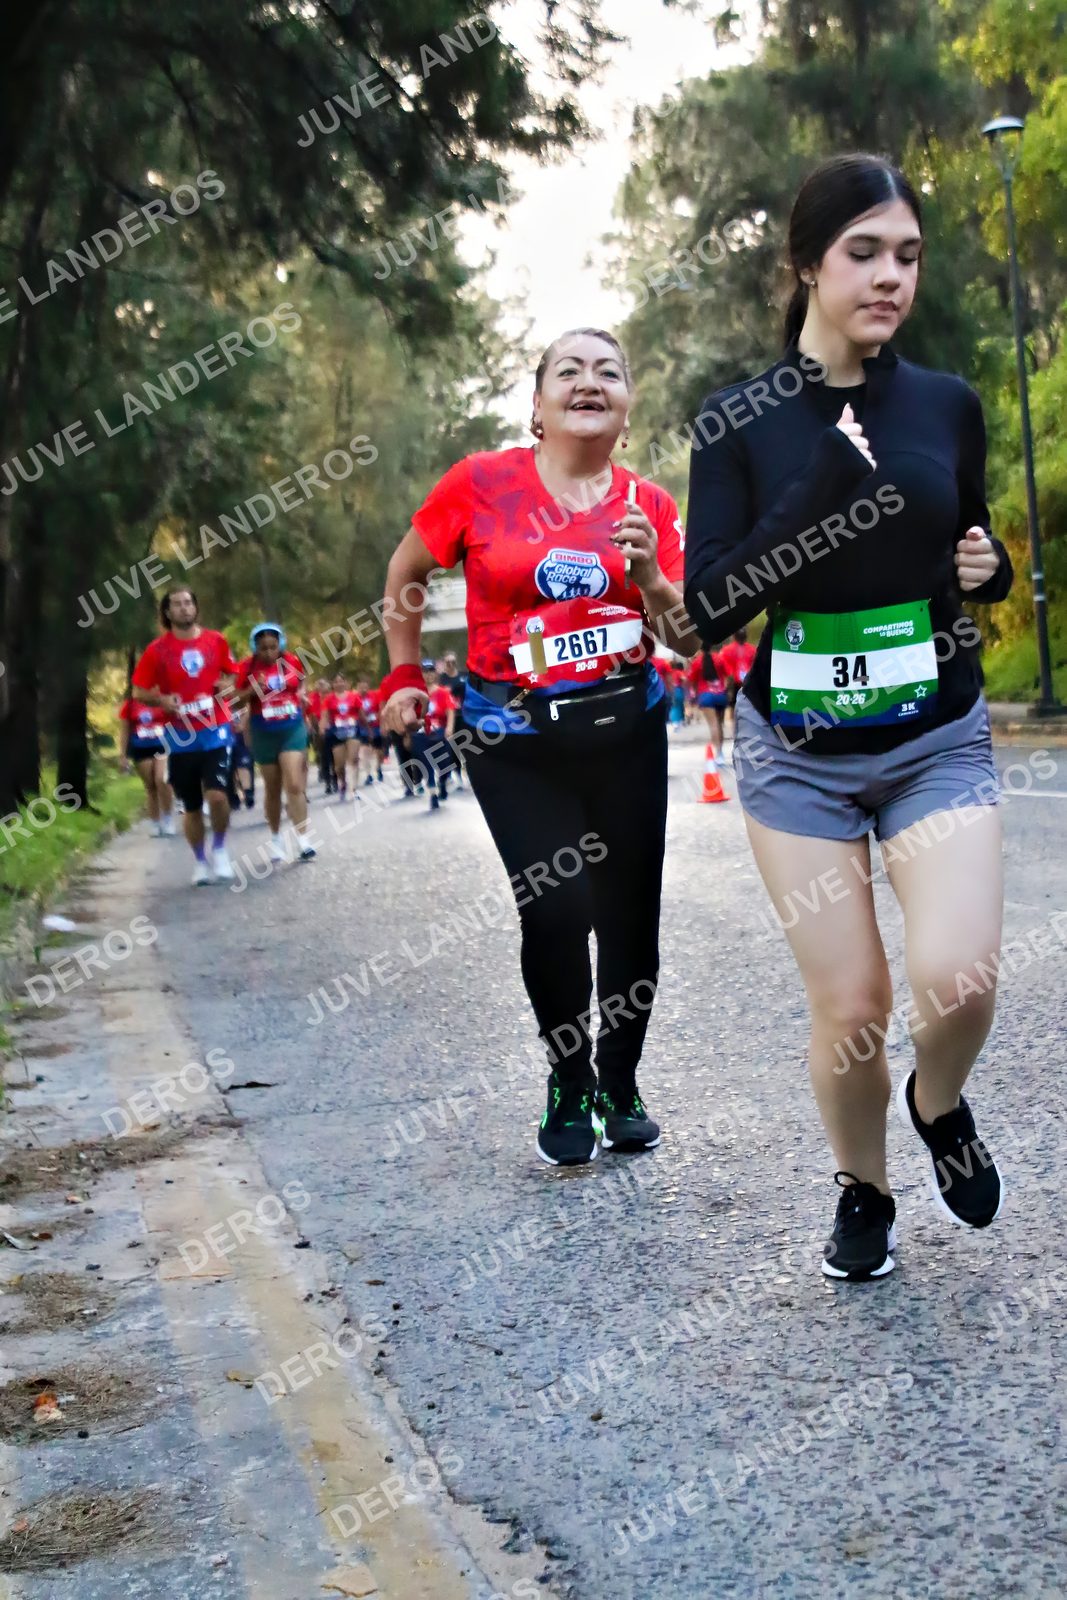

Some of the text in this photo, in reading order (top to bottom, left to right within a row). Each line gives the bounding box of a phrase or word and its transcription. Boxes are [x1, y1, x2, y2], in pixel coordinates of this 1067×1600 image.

[555, 553, 593, 564] BIMBO
[555, 564, 591, 577] Global
[546, 571, 577, 584] Race
[863, 620, 914, 634] COMPARTIMOS
[554, 628, 607, 661] 2667
[832, 655, 869, 688] 34
